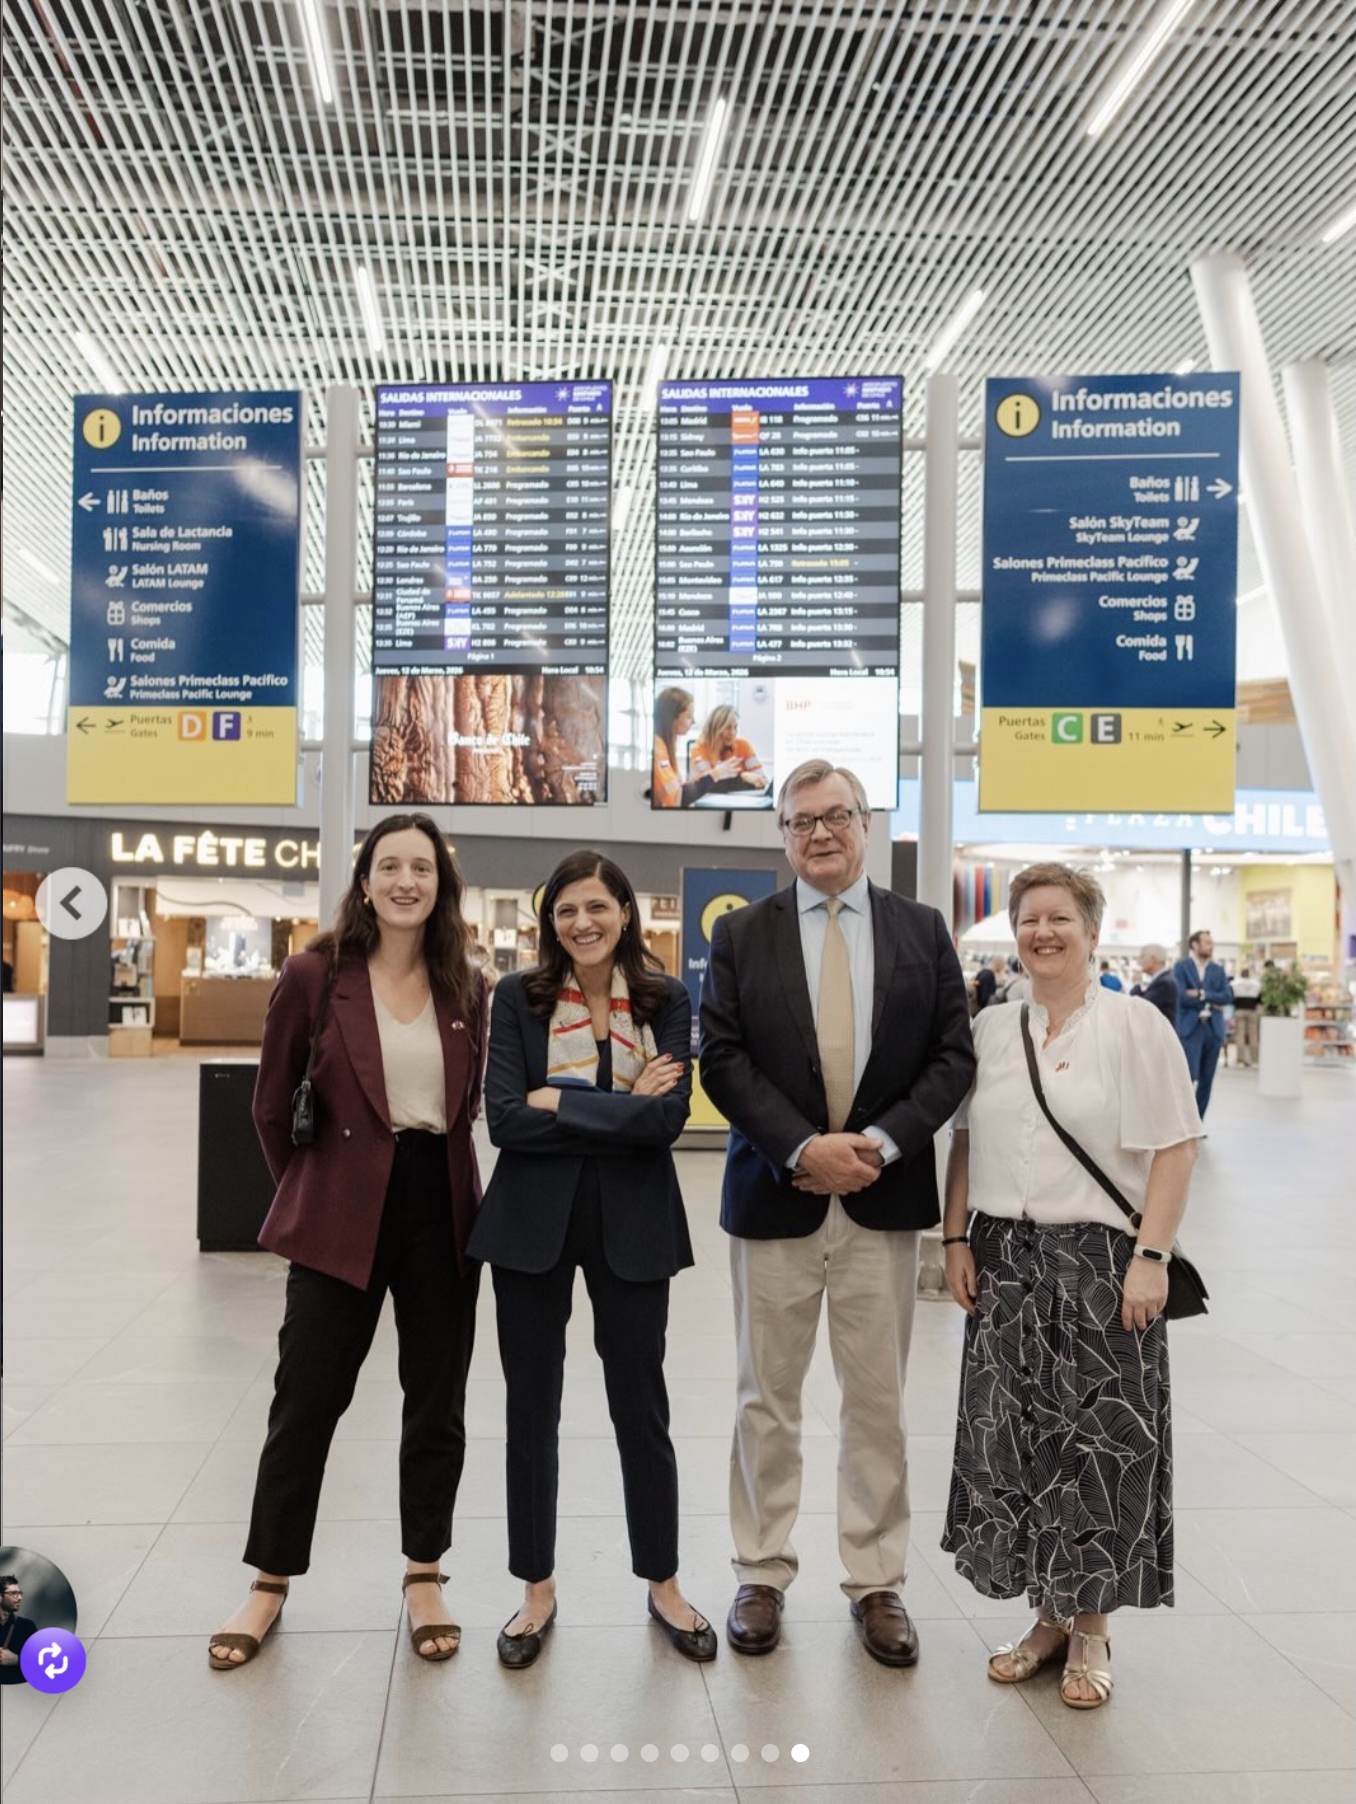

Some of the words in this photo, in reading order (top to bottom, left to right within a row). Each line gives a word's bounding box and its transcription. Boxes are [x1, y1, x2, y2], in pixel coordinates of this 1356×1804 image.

[380, 392, 425, 404] SALIDAS
[425, 389, 522, 403] INTERNACIONALES
[661, 387, 708, 399] SALIDAS
[708, 385, 809, 398] INTERNACIONALES
[1052, 386, 1233, 412] Informaciones
[132, 402, 294, 426] Informaciones
[1052, 417, 1181, 439] Information
[132, 432, 248, 451] Information
[1129, 476, 1171, 489] Baños
[132, 488, 169, 501] Baños
[1134, 491, 1170, 503] Toilets
[133, 503, 165, 514] Toilets
[1069, 516, 1106, 530] Salón
[1109, 516, 1170, 531] SkyTeam
[132, 526, 157, 538] Sala
[159, 526, 175, 538] de
[178, 525, 233, 538] Lactancia
[1075, 532, 1126, 545] SkyTeam
[1127, 533, 1170, 545] Lounge
[132, 541, 171, 553] Nursing
[172, 541, 201, 550] Room
[132, 563, 165, 575] Salón
[167, 563, 209, 575] LATAM
[993, 556, 1044, 569] Salones
[1046, 556, 1115, 569] Primeclass
[132, 578, 166, 588] LATAM
[168, 578, 204, 590] Lounge
[1031, 571, 1088, 583] Primeclass
[1090, 571, 1126, 582] Pacific
[1126, 571, 1168, 584] Lounge
[131, 600, 193, 613] Comercios
[1098, 595, 1168, 609] Comercios
[131, 616, 161, 627] Shops
[1133, 610, 1168, 623] Shops
[130, 637, 176, 650] Comida
[1116, 635, 1168, 648] Comida
[130, 652, 156, 663] Food
[1138, 650, 1168, 662] Food
[130, 674, 176, 687] Salones
[178, 674, 240, 687] Primeclass
[130, 689, 180, 699] Primeclass
[182, 689, 213, 699] Pacific
[215, 689, 253, 702] Lounge
[786, 701, 812, 711] BHP
[130, 714, 172, 725] Puertas
[181, 713, 203, 739] D
[219, 714, 234, 738] F
[999, 715, 1046, 727] Puertas
[1057, 715, 1078, 741] C
[1097, 716, 1115, 742] E
[130, 728, 158, 738] Gates
[246, 728, 253, 738] 9
[255, 728, 275, 738] min
[448, 732, 485, 747] Banco
[486, 733, 499, 746] de
[502, 732, 532, 747] Chile
[1014, 731, 1046, 741] Gates
[1128, 732, 1141, 741] 11
[1143, 731, 1165, 741] min
[111, 832, 164, 863] LA
[173, 829, 266, 867] FÊTE
